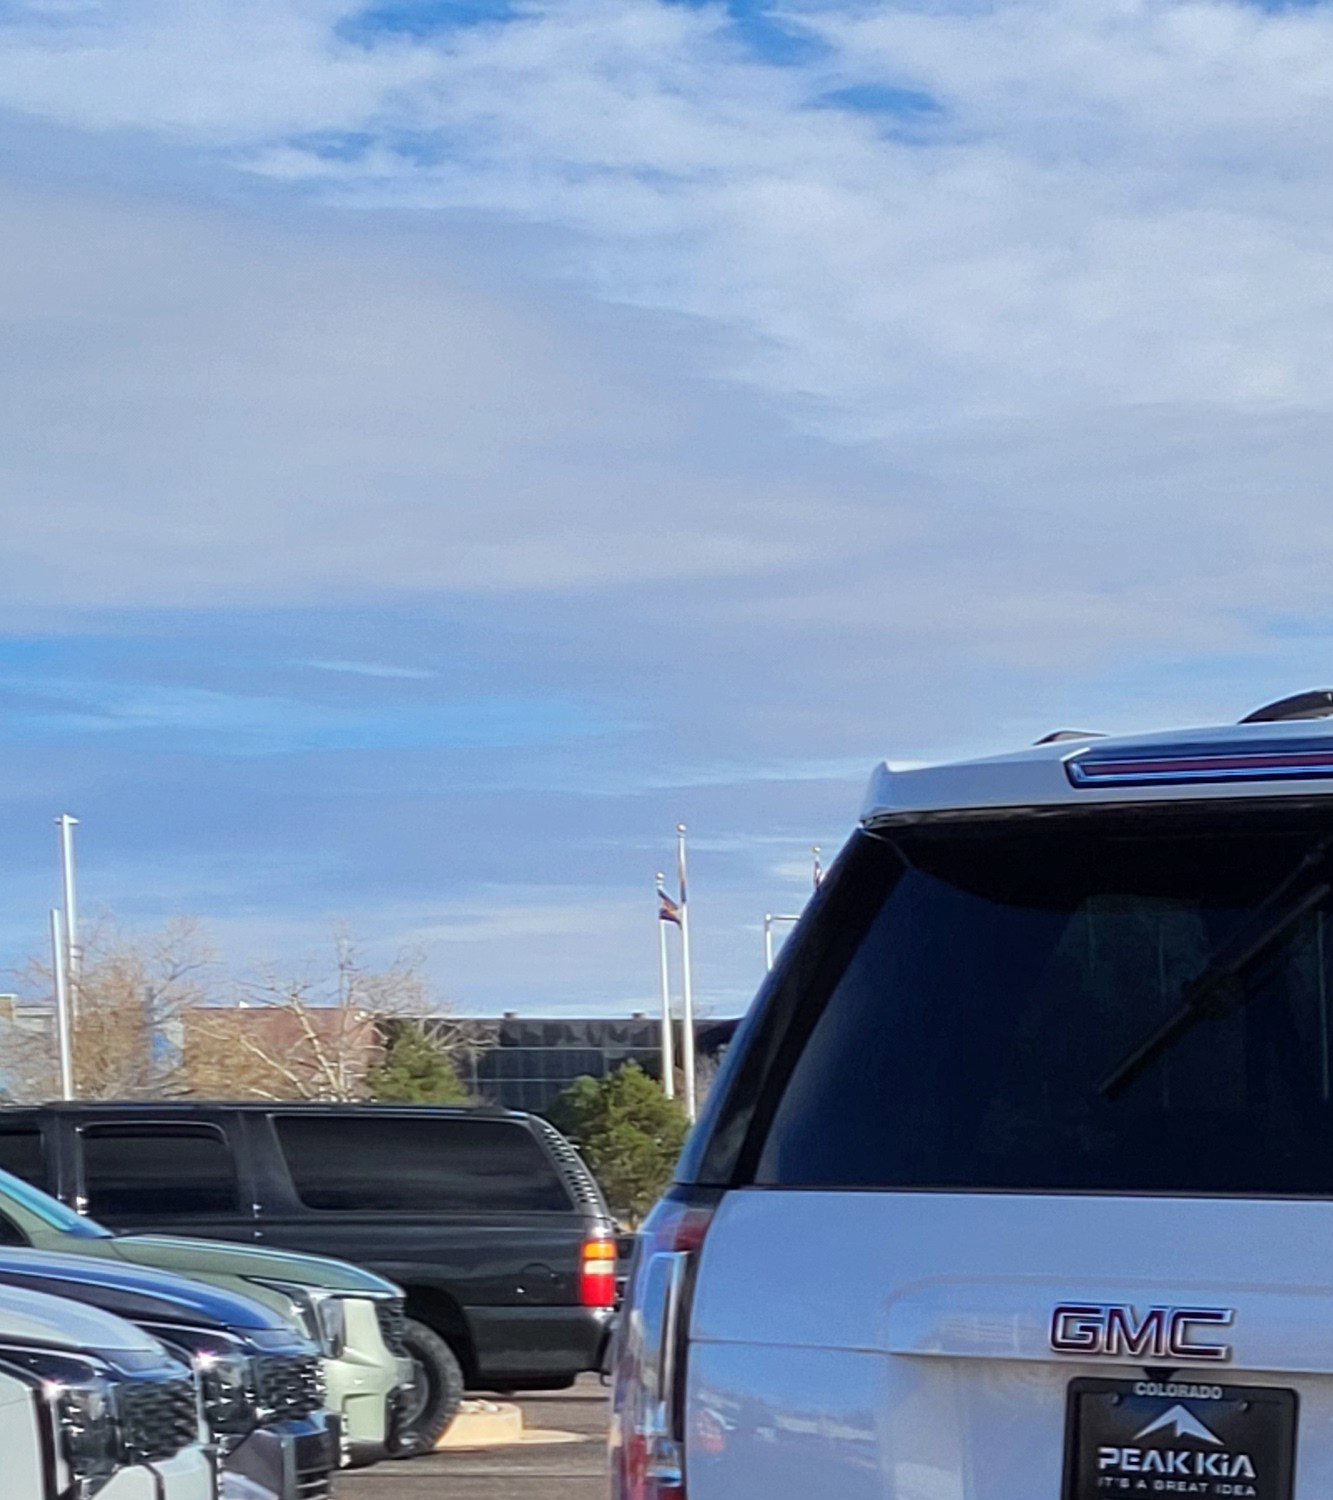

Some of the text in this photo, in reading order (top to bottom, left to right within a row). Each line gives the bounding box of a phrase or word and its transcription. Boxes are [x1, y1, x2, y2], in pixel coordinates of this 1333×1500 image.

[1050, 1301, 1236, 1362] GMC
[1133, 1382, 1222, 1399] COLORADO
[1097, 1446, 1191, 1474] PEAK
[1098, 1476, 1257, 1496] IT'S A GREAT IDEA
